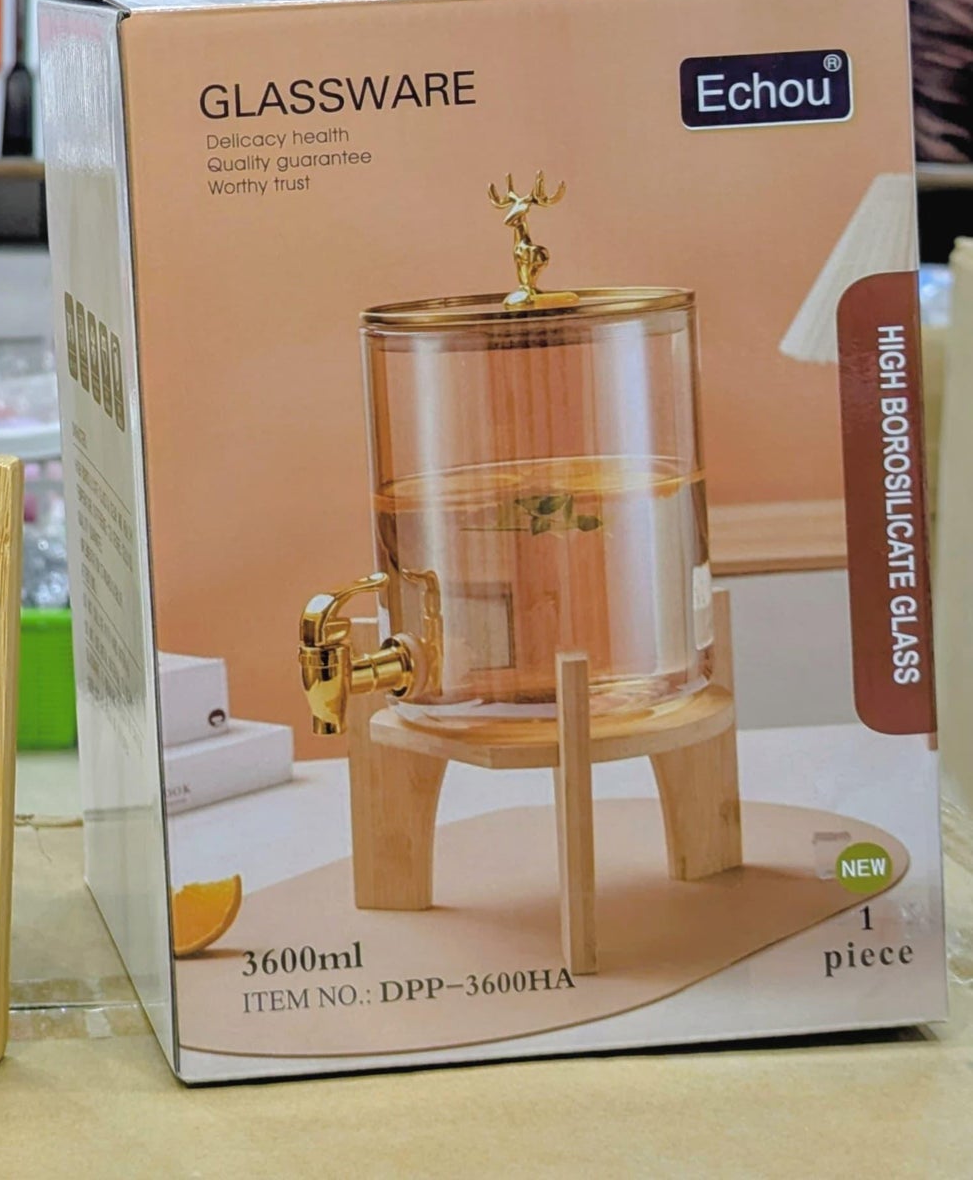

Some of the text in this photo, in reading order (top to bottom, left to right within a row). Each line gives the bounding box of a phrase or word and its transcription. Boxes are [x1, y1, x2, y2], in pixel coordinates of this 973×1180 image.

[200, 70, 477, 119] GLASSWARE
[207, 127, 349, 150] Delicacy health
[207, 150, 372, 172] Quality guarantee
[208, 175, 311, 195] Worthy trust
[878, 325, 920, 685] HIGH BOROSILICATE GLASS
[841, 858, 886, 878] NEW
[860, 905, 873, 930] 1
[242, 941, 363, 977] 3600ml
[824, 942, 914, 978] piece
[243, 967, 576, 1013] ITEM NO.: DPP-3600HA
